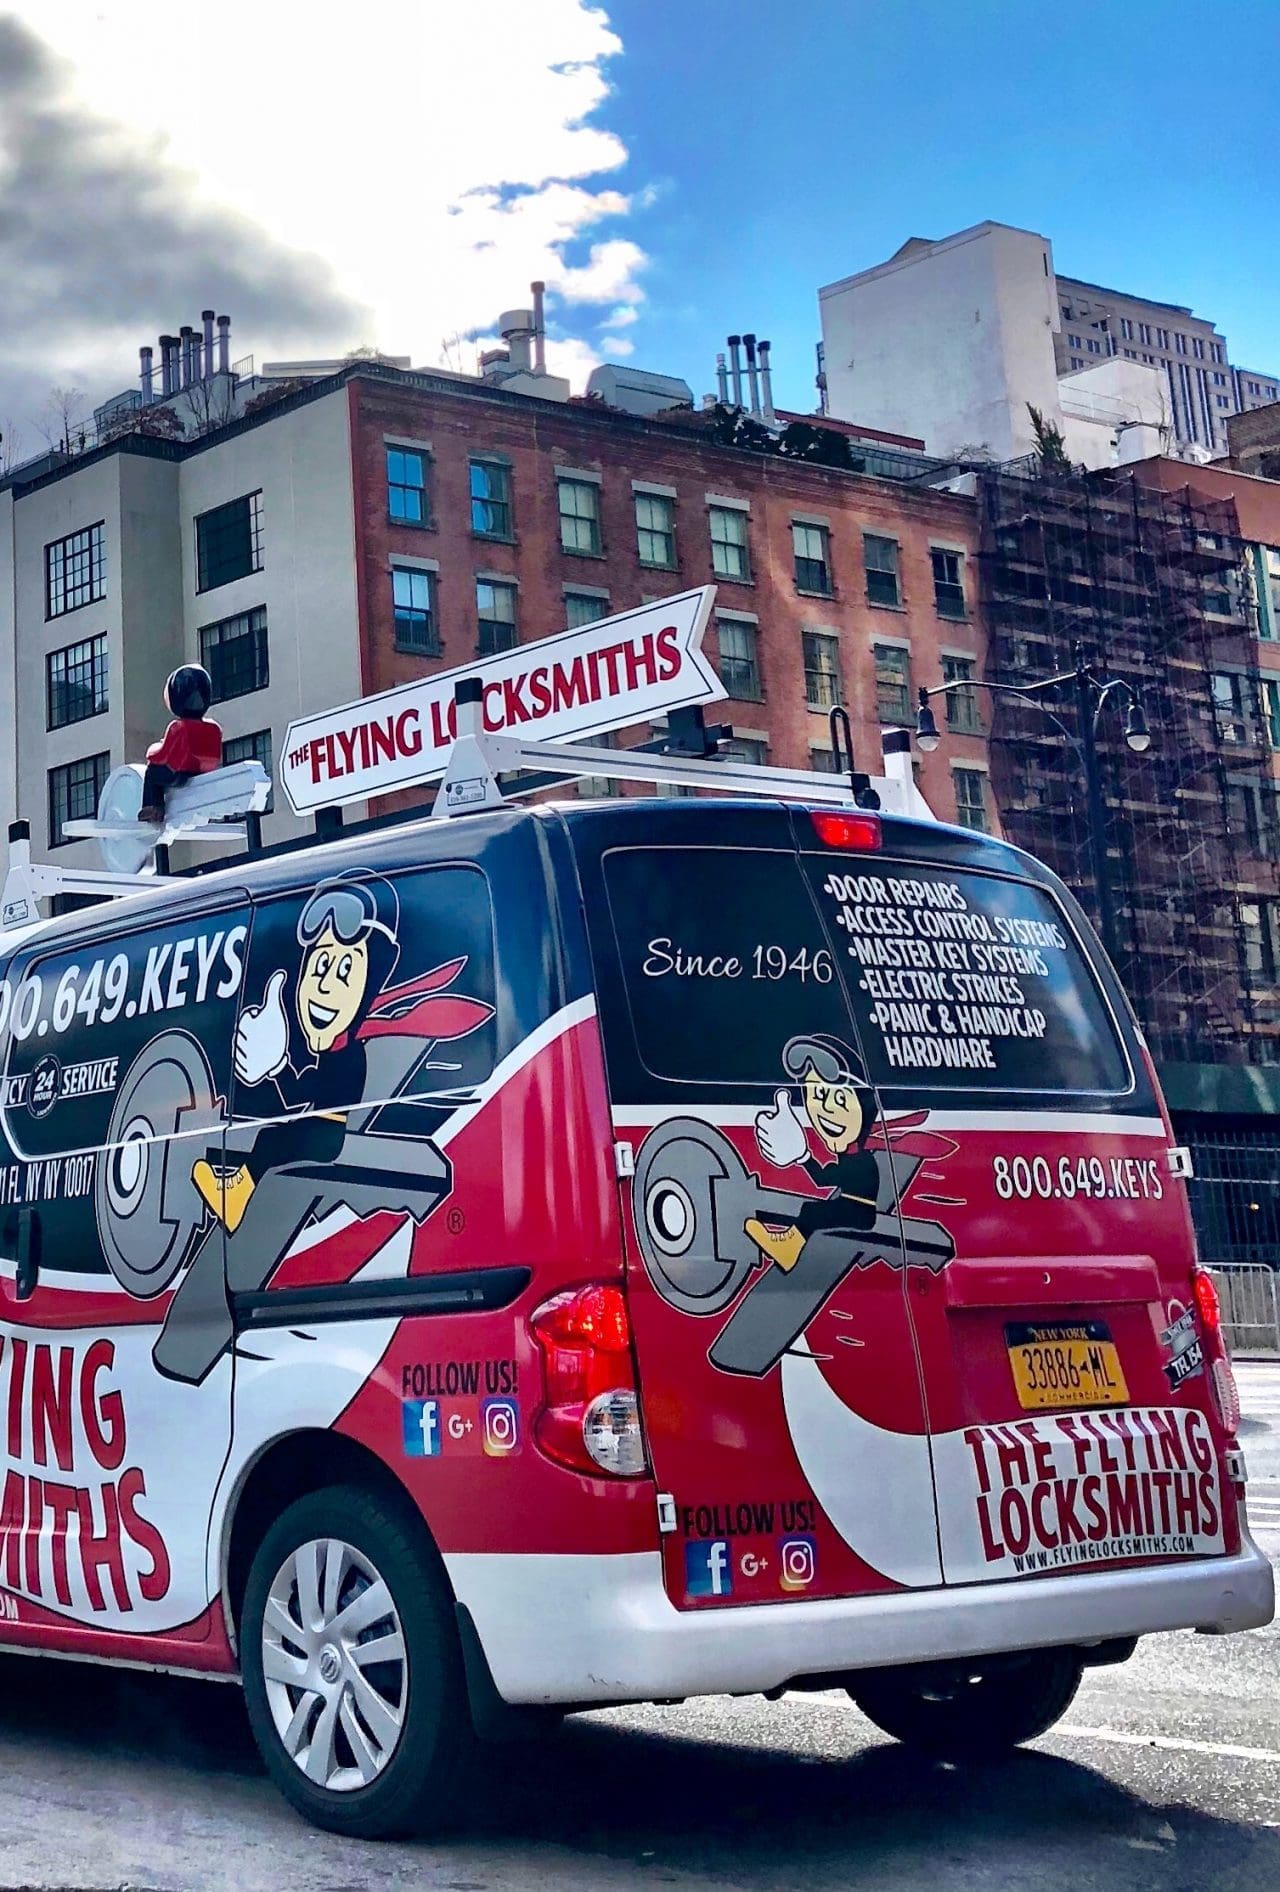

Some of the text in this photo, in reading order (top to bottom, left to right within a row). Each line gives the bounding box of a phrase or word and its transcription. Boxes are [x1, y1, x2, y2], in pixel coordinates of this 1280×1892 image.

[289, 745, 310, 770] THE
[310, 708, 420, 785] FLYING
[828, 874, 967, 911] DOOR REPAIRS
[842, 906, 1067, 950] ACCESS CONTROL SYSTEMS
[642, 937, 833, 983] Since 1946
[853, 937, 1049, 976] MASTER KEY SYSTEMS
[864, 969, 1025, 1006] ELECTRIC STRIKES
[874, 1002, 1047, 1038] PANIC & HANDICAP
[883, 1036, 997, 1069] HARDWARE
[34, 1069, 56, 1092] 24
[61, 1061, 119, 1096] SERVICE
[25, 1162, 43, 1202] NY
[44, 1160, 61, 1200] NY
[64, 1155, 95, 1198] 10017
[993, 1155, 1163, 1200] 800.649.KEYS
[1035, 1327, 1089, 1342] NEW YORK
[402, 1359, 518, 1396] FOLLOW US!
[448, 1414, 473, 1440] G+
[964, 1409, 1212, 1494] THE FLYING
[682, 1501, 816, 1537] FOLLOW US!
[976, 1471, 1219, 1563] LOCKSMITHS
[740, 1553, 769, 1577] G+
[1013, 1536, 1195, 1573] WWW.FLYINGLOCKSMITHS.COM
